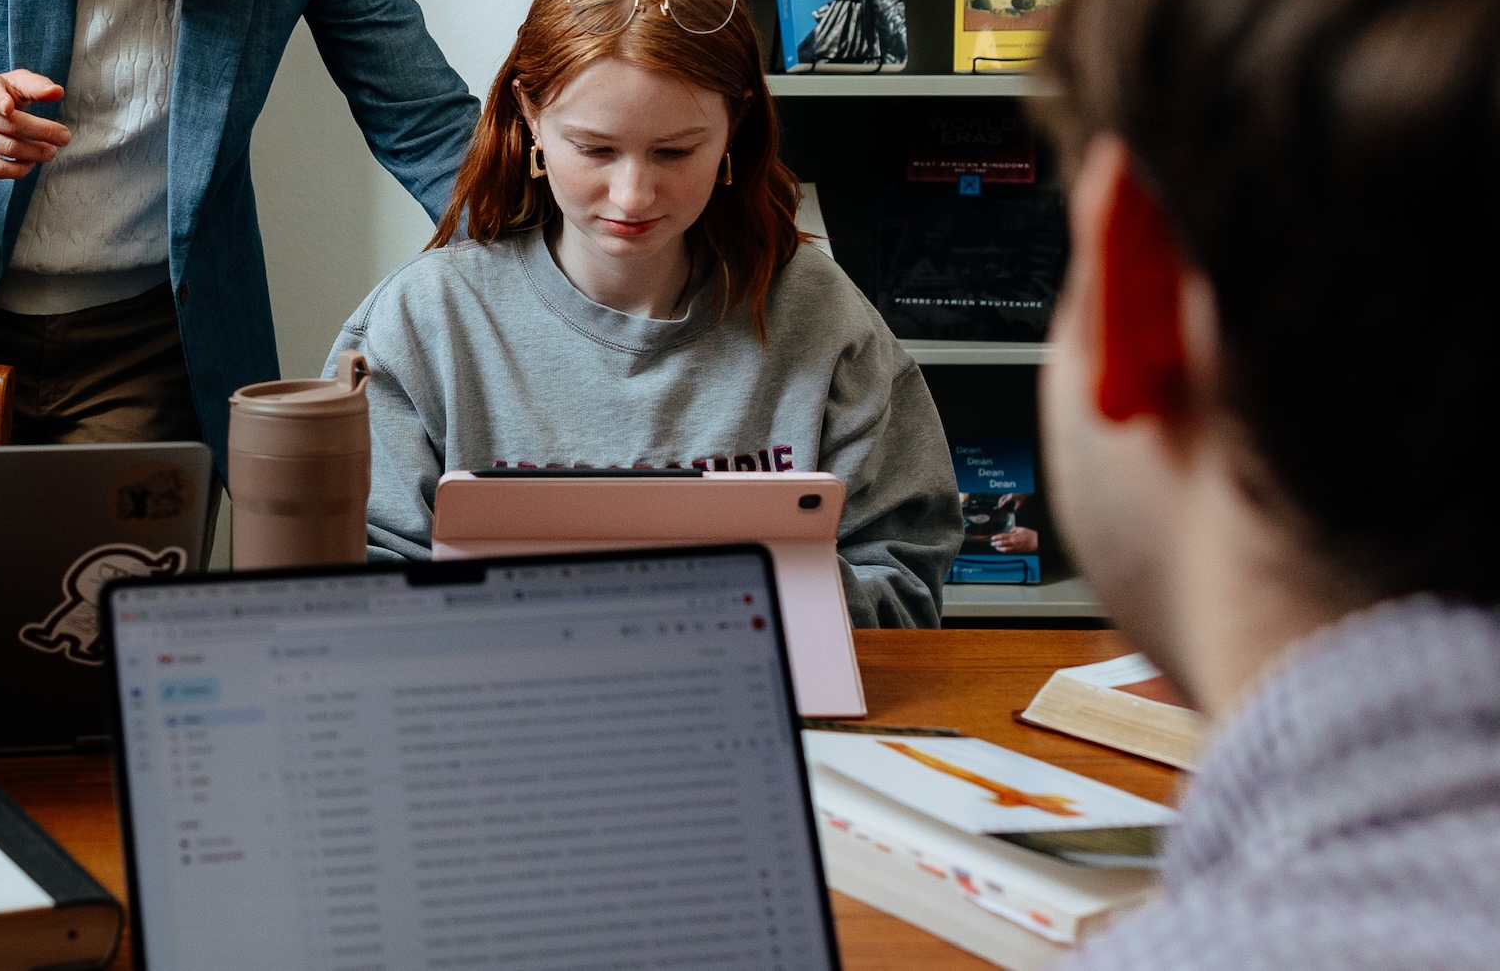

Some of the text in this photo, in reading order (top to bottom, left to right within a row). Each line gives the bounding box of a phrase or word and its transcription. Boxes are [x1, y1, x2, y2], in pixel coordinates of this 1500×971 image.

[966, 457, 993, 466] Dean
[978, 468, 1005, 477] Dean
[989, 480, 1017, 489] Dean
